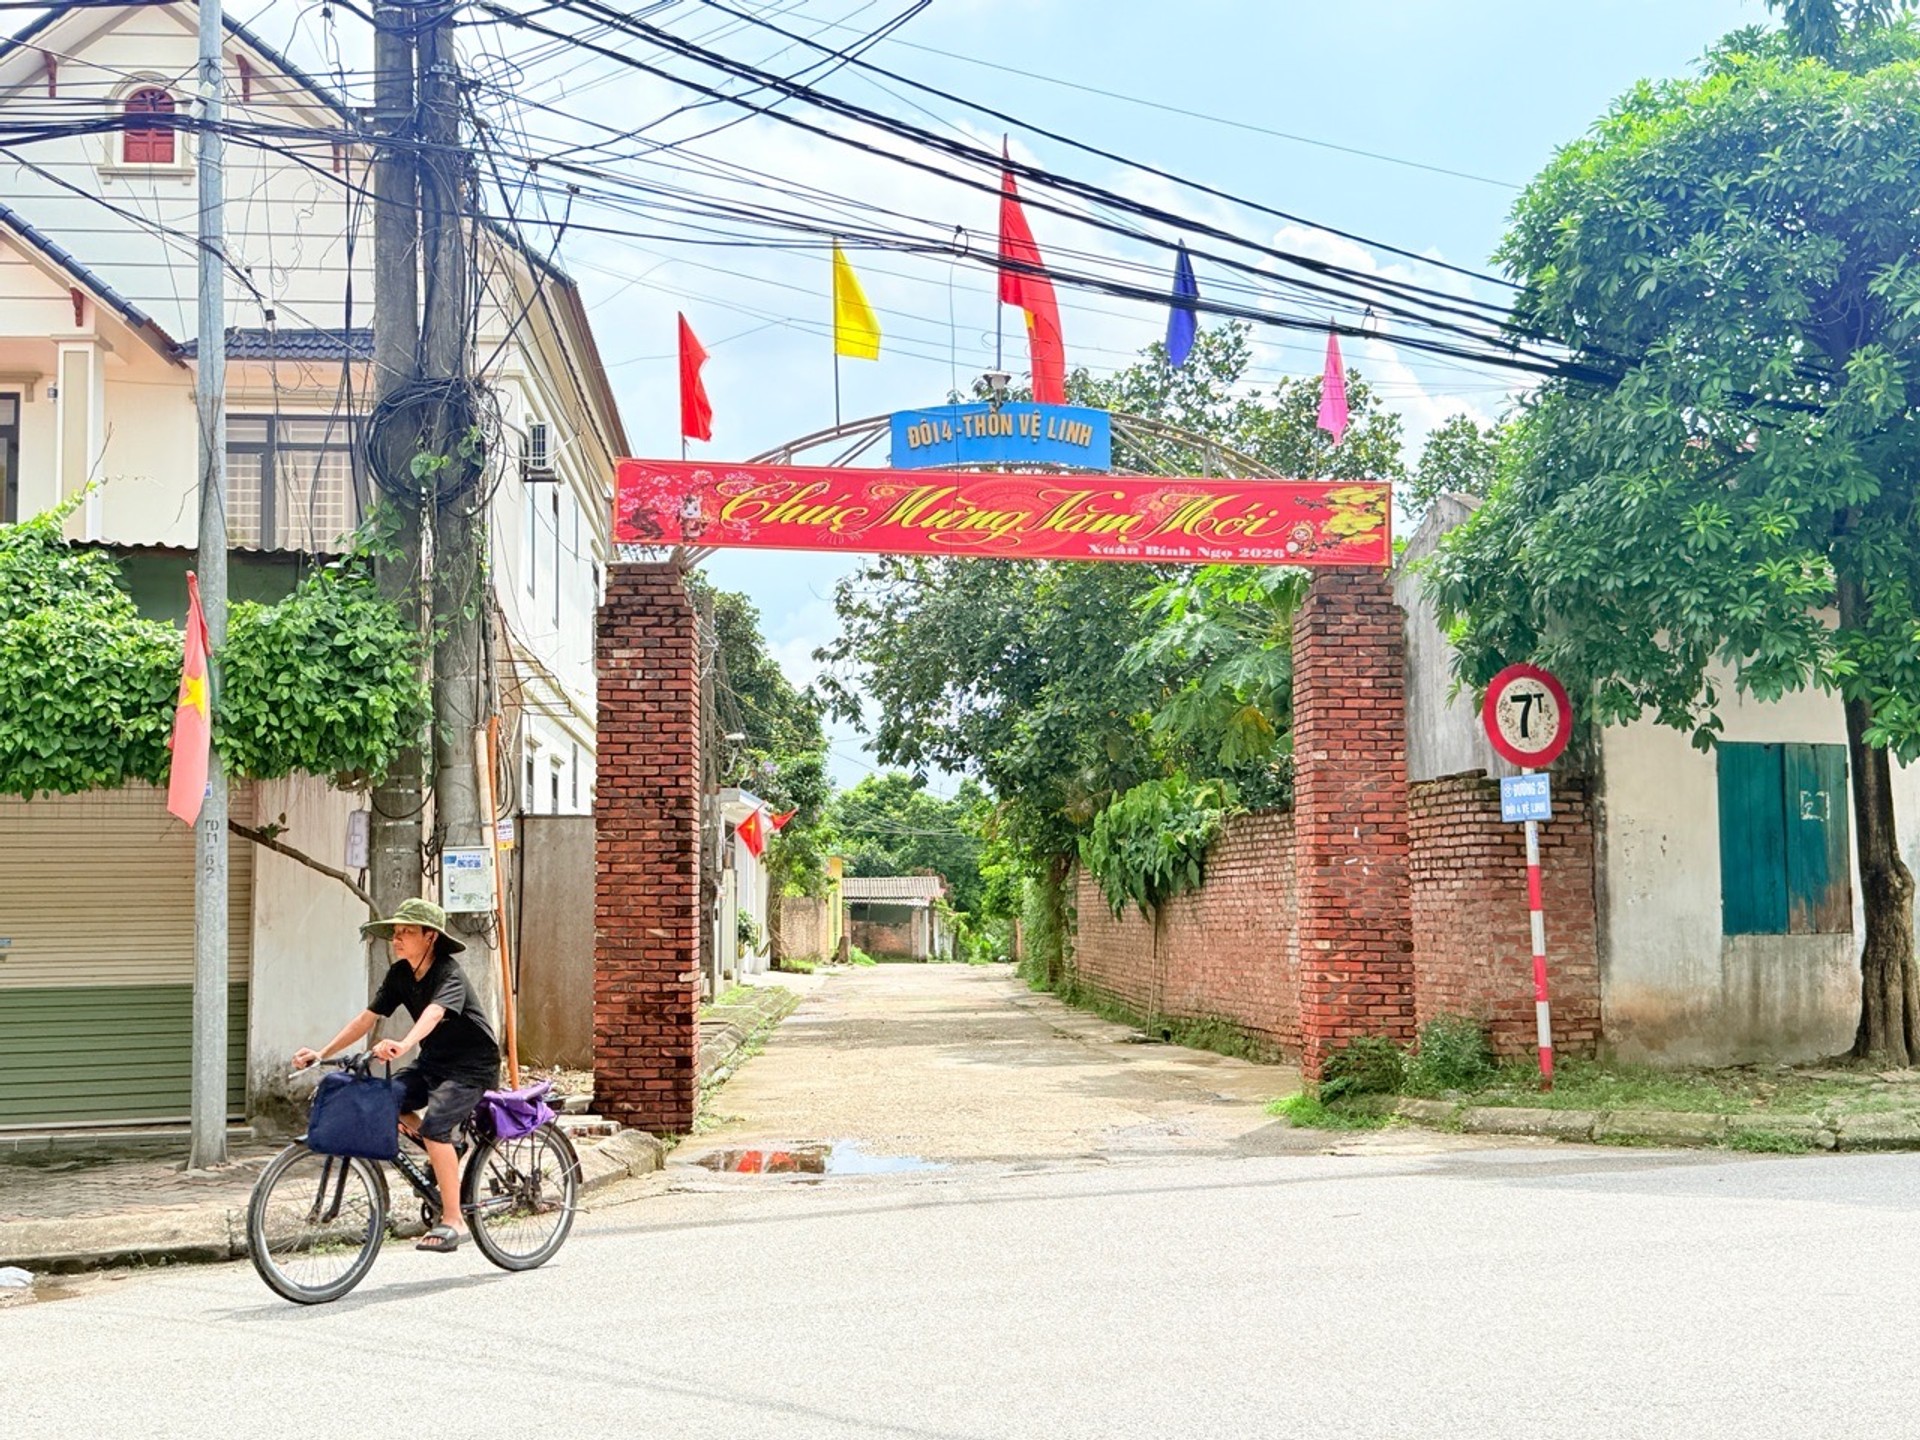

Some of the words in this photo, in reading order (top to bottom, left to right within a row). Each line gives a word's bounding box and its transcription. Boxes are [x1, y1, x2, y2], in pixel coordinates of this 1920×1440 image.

[1019, 409, 1041, 442] VỆ
[1047, 416, 1093, 447] LINH
[716, 481, 869, 534] Chúc
[830, 484, 1033, 548] Mừng
[1016, 488, 1144, 533] Năm
[1118, 493, 1291, 545] Mới
[1088, 543, 1139, 555] Xuân
[1146, 545, 1191, 556] Bính
[1198, 547, 1232, 560] Ngọ
[1238, 547, 1285, 558] 2026
[397, 1151, 430, 1186] CTION
